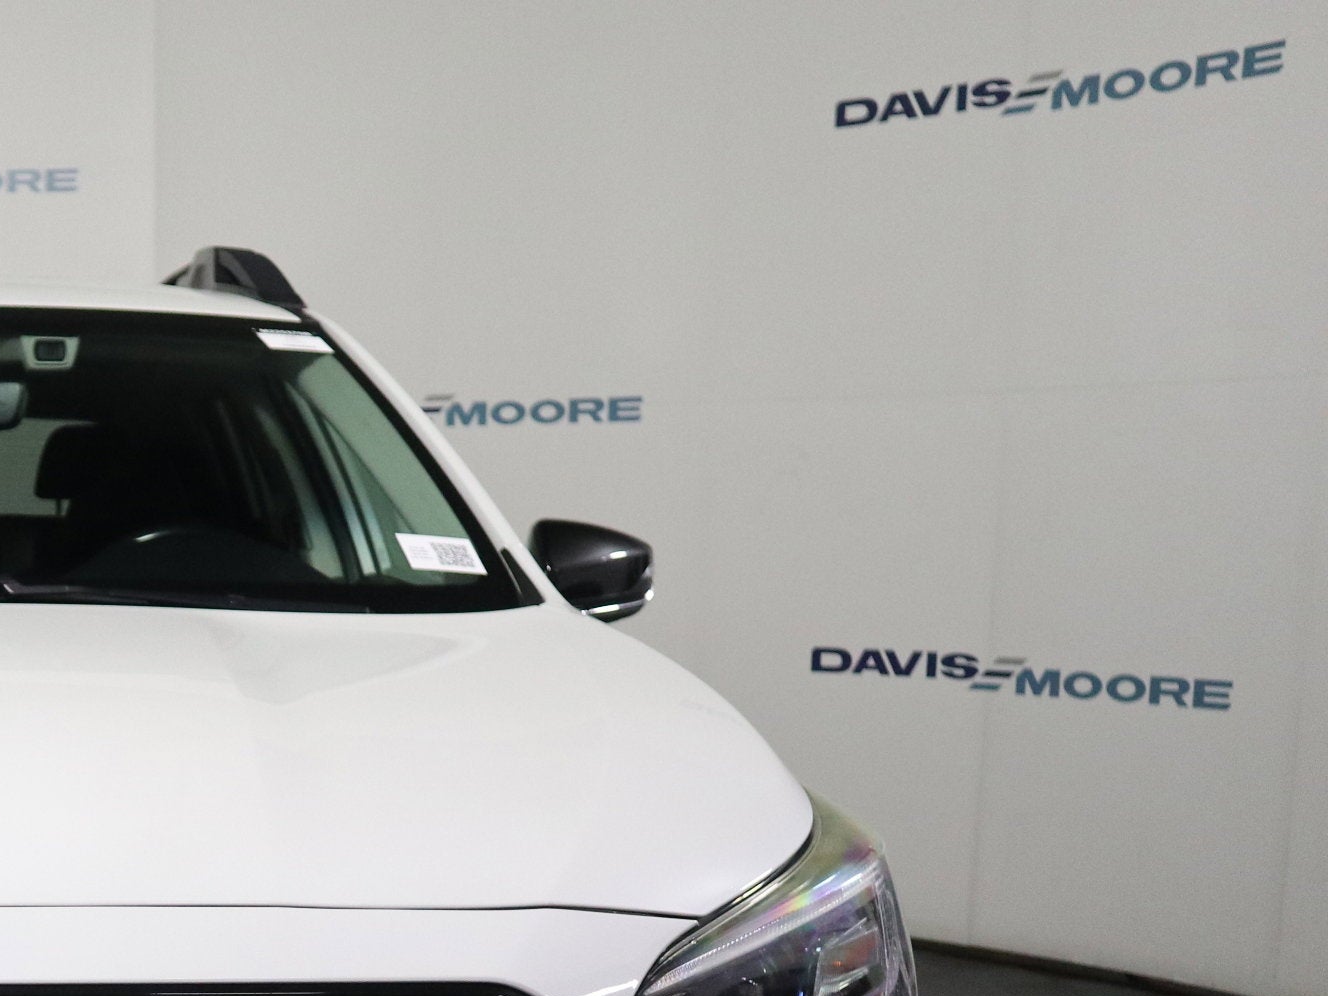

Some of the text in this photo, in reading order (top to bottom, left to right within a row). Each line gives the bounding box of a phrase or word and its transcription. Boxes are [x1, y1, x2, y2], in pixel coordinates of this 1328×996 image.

[835, 39, 1287, 127] DAVIS MOORE
[446, 395, 643, 426] MOORE
[810, 646, 1233, 711] DAVIS MOORE
